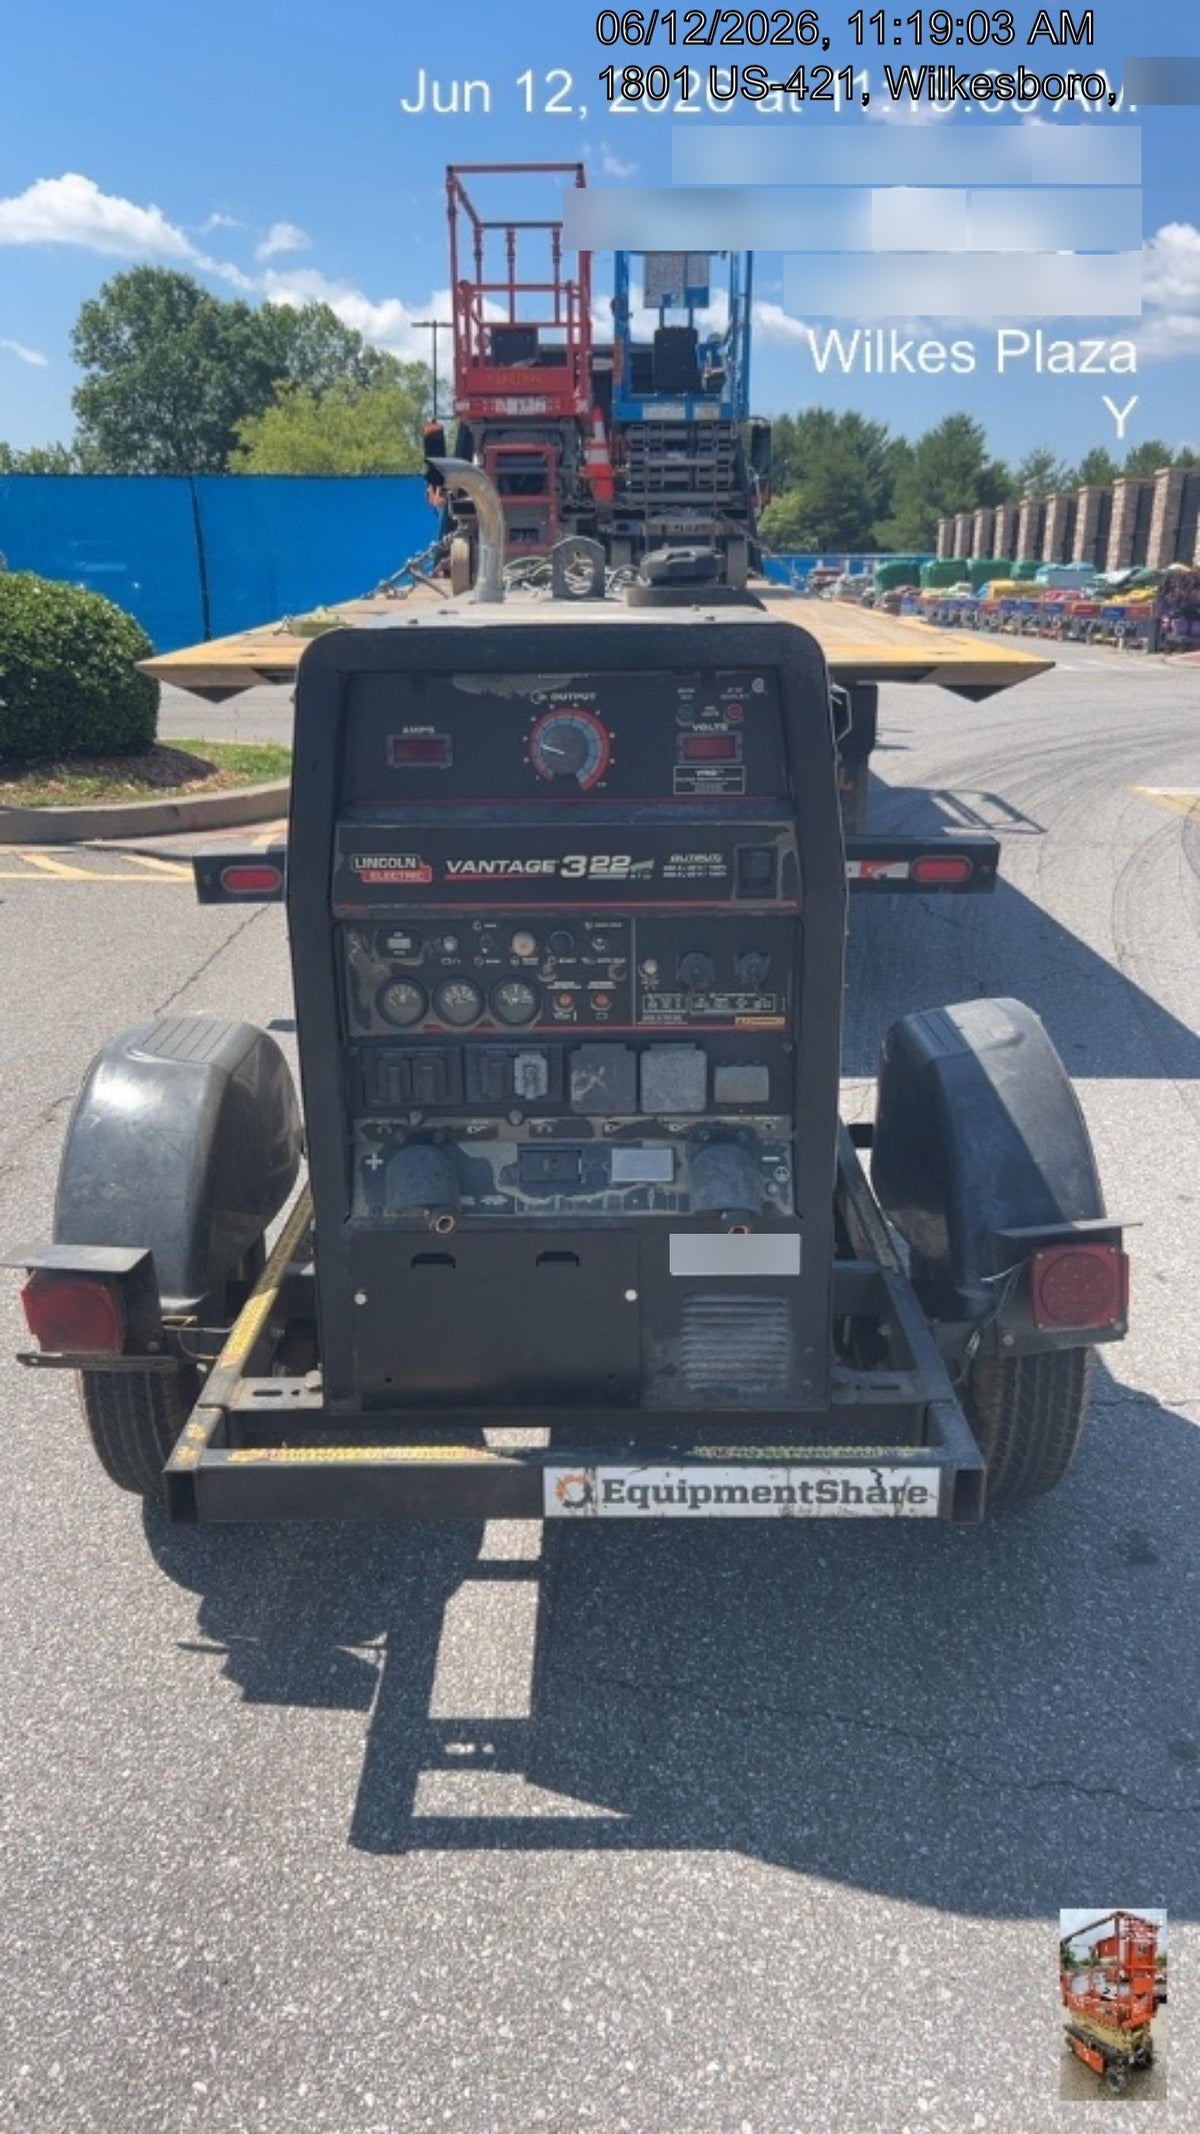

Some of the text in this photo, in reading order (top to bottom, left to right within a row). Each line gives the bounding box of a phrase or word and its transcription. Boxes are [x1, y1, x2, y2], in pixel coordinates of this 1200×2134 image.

[550, 692, 597, 702] OUTPUT
[692, 722, 729, 732] VOLTS
[355, 857, 416, 869] LINCOLN
[446, 859, 562, 873] VANTAGE
[560, 855, 632, 878] 322
[369, 869, 426, 881] ELECTRIC
[601, 1478, 929, 1510] EquipmentShare
